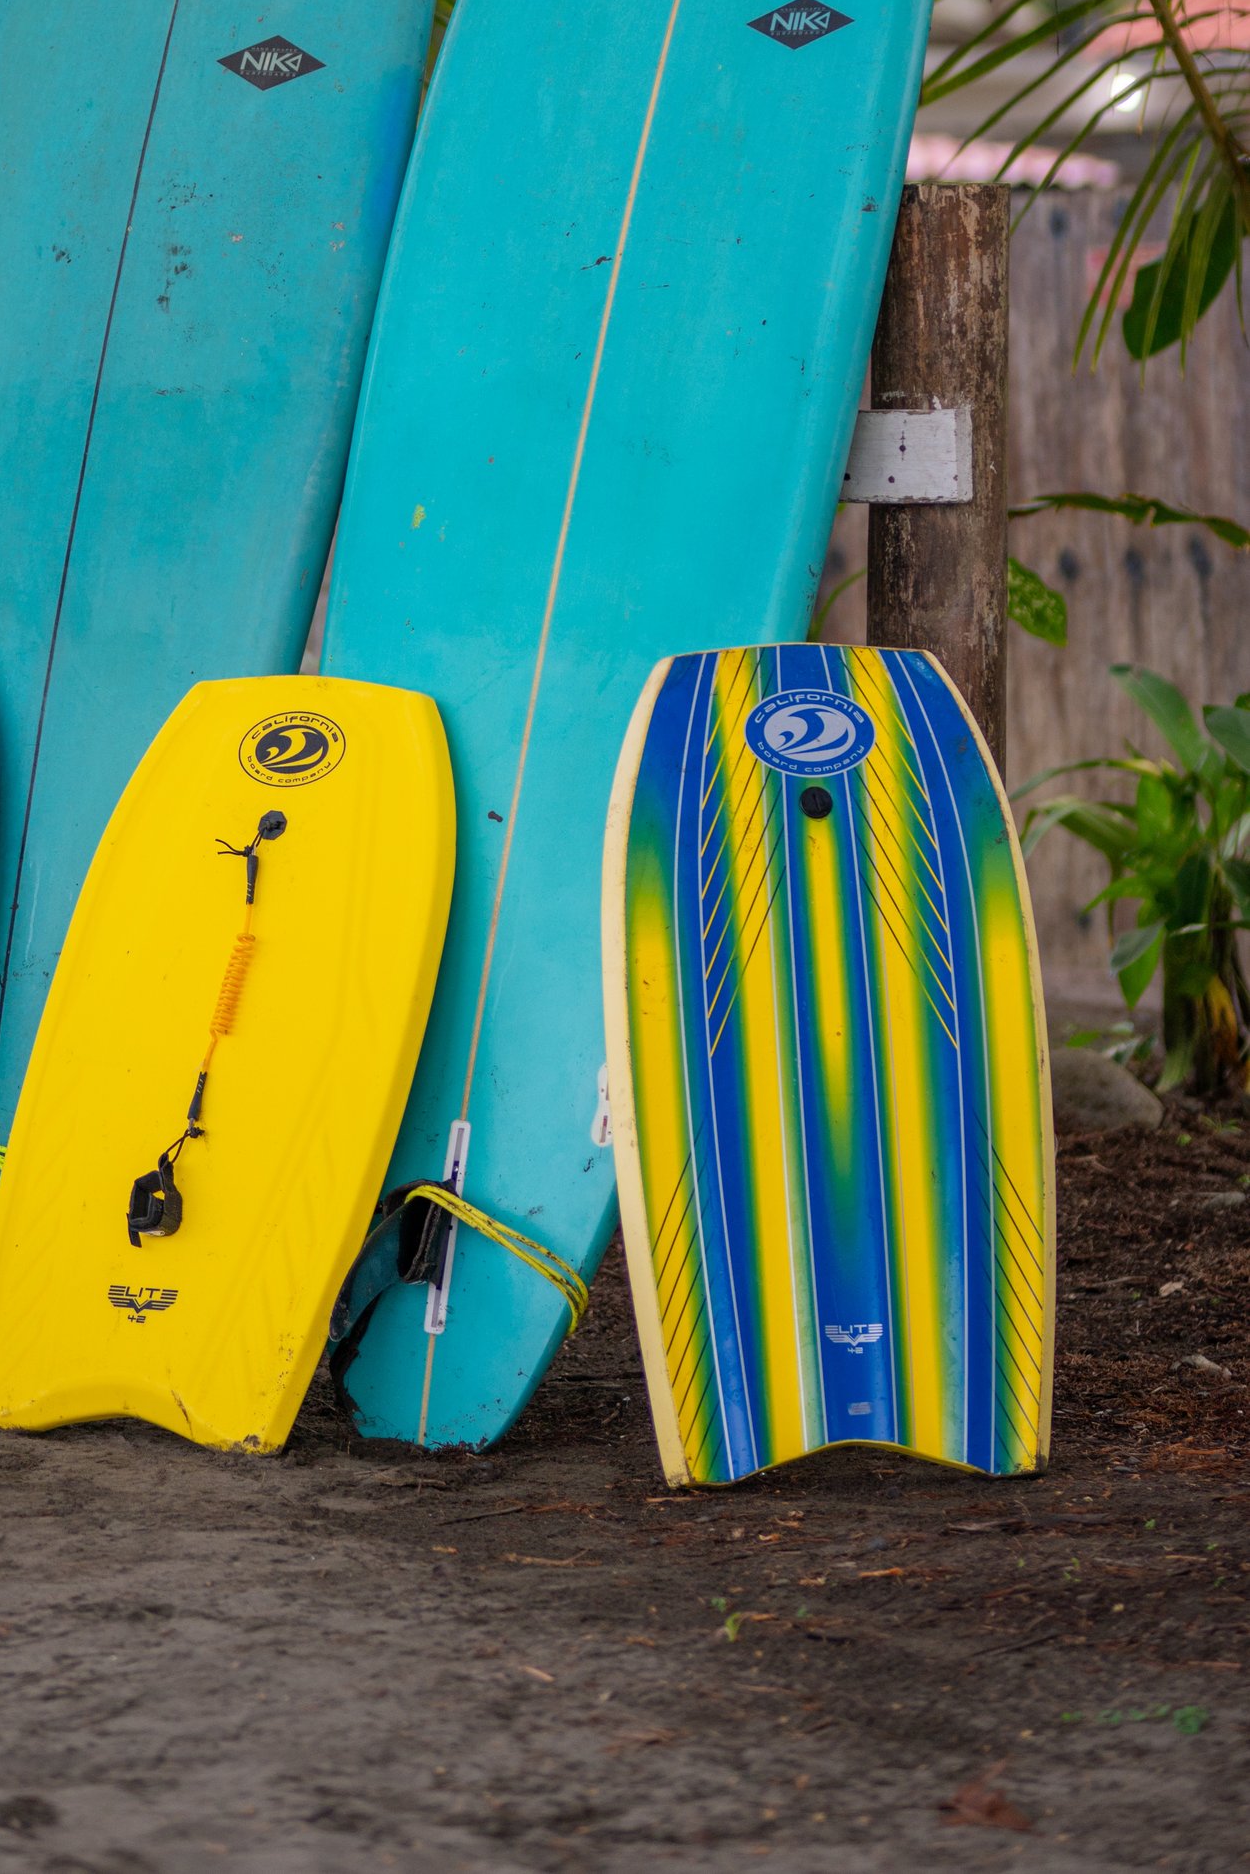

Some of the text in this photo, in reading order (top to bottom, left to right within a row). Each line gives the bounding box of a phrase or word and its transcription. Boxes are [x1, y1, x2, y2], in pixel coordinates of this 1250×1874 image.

[247, 755, 332, 783] board company
[757, 741, 865, 773] board company
[127, 1314, 147, 1324] 42
